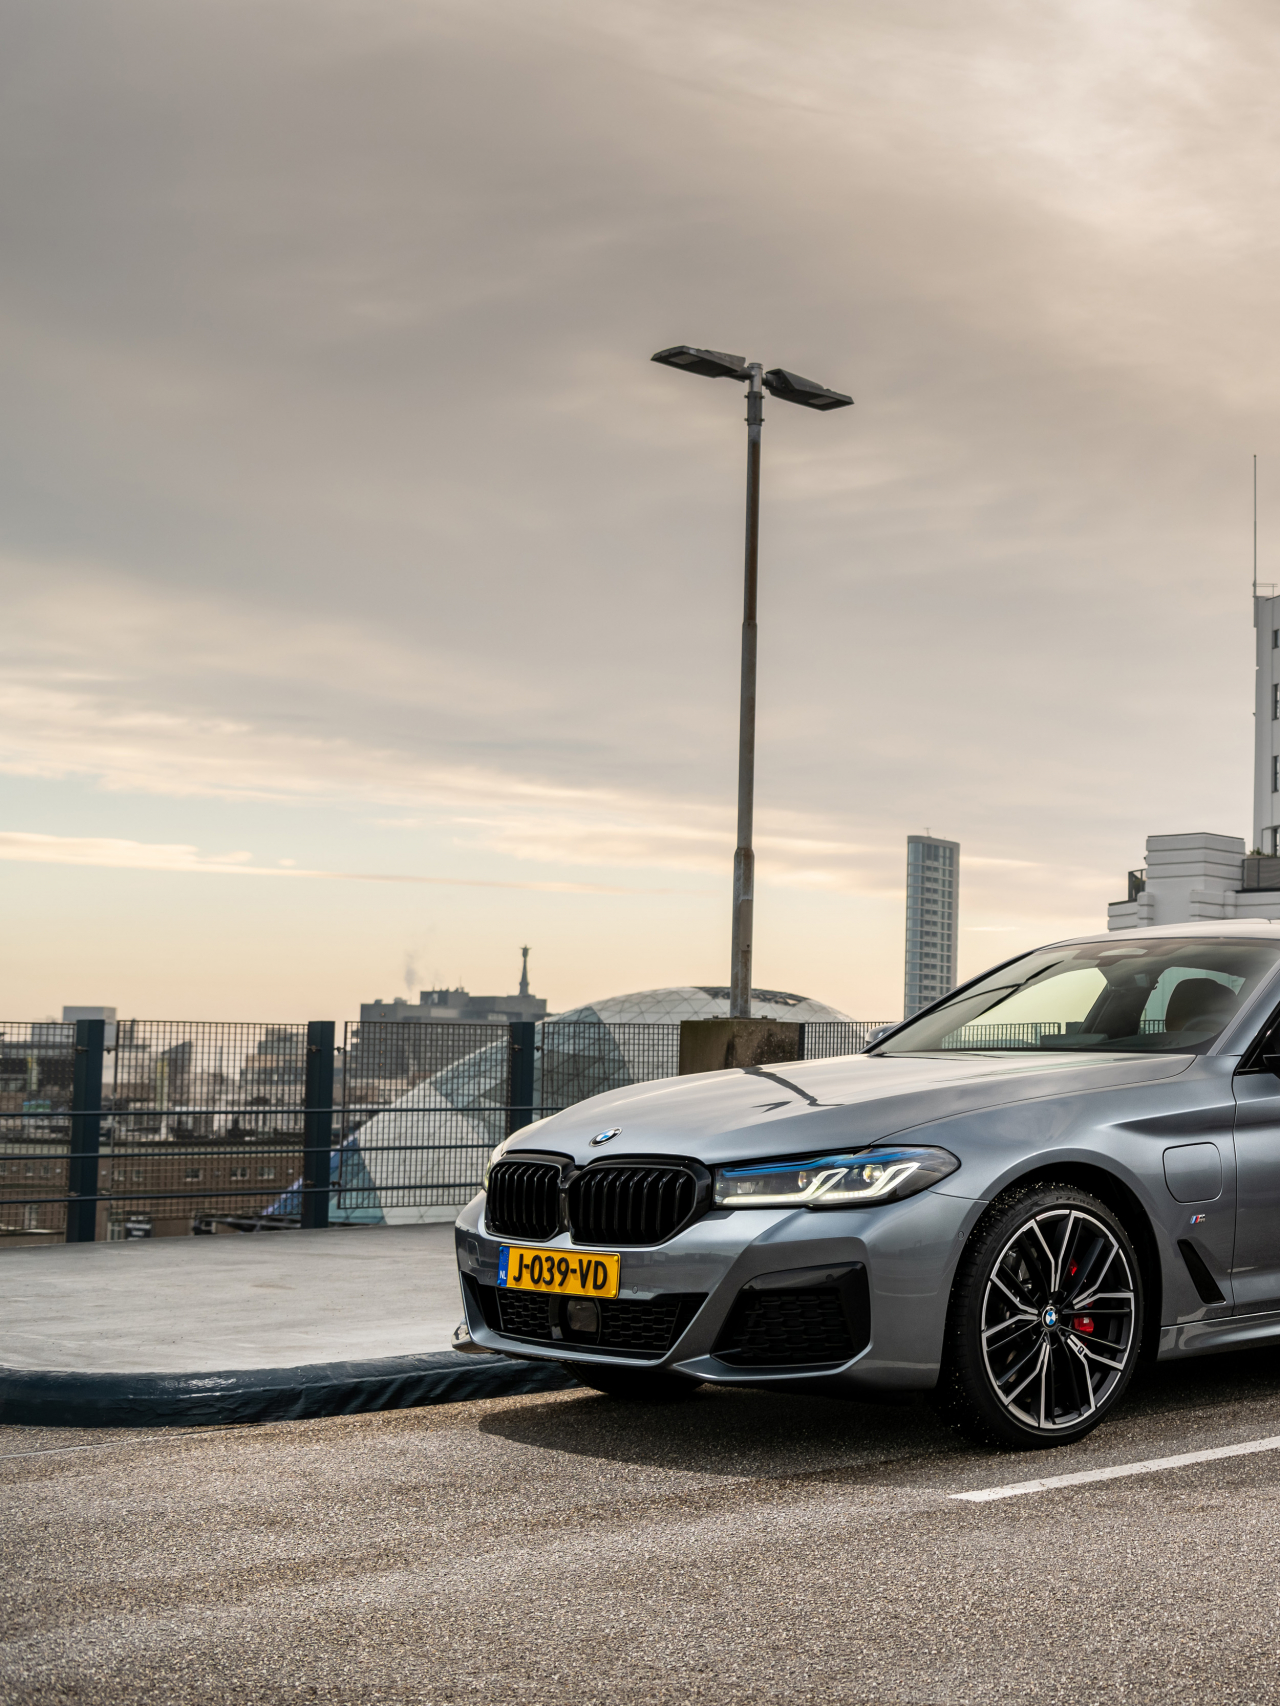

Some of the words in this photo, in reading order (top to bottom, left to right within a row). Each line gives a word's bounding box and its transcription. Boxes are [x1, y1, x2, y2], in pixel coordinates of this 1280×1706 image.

[1065, 1196, 1094, 1207] ZERO
[499, 1270, 507, 1280] NL
[513, 1253, 608, 1290] J-039-VD
